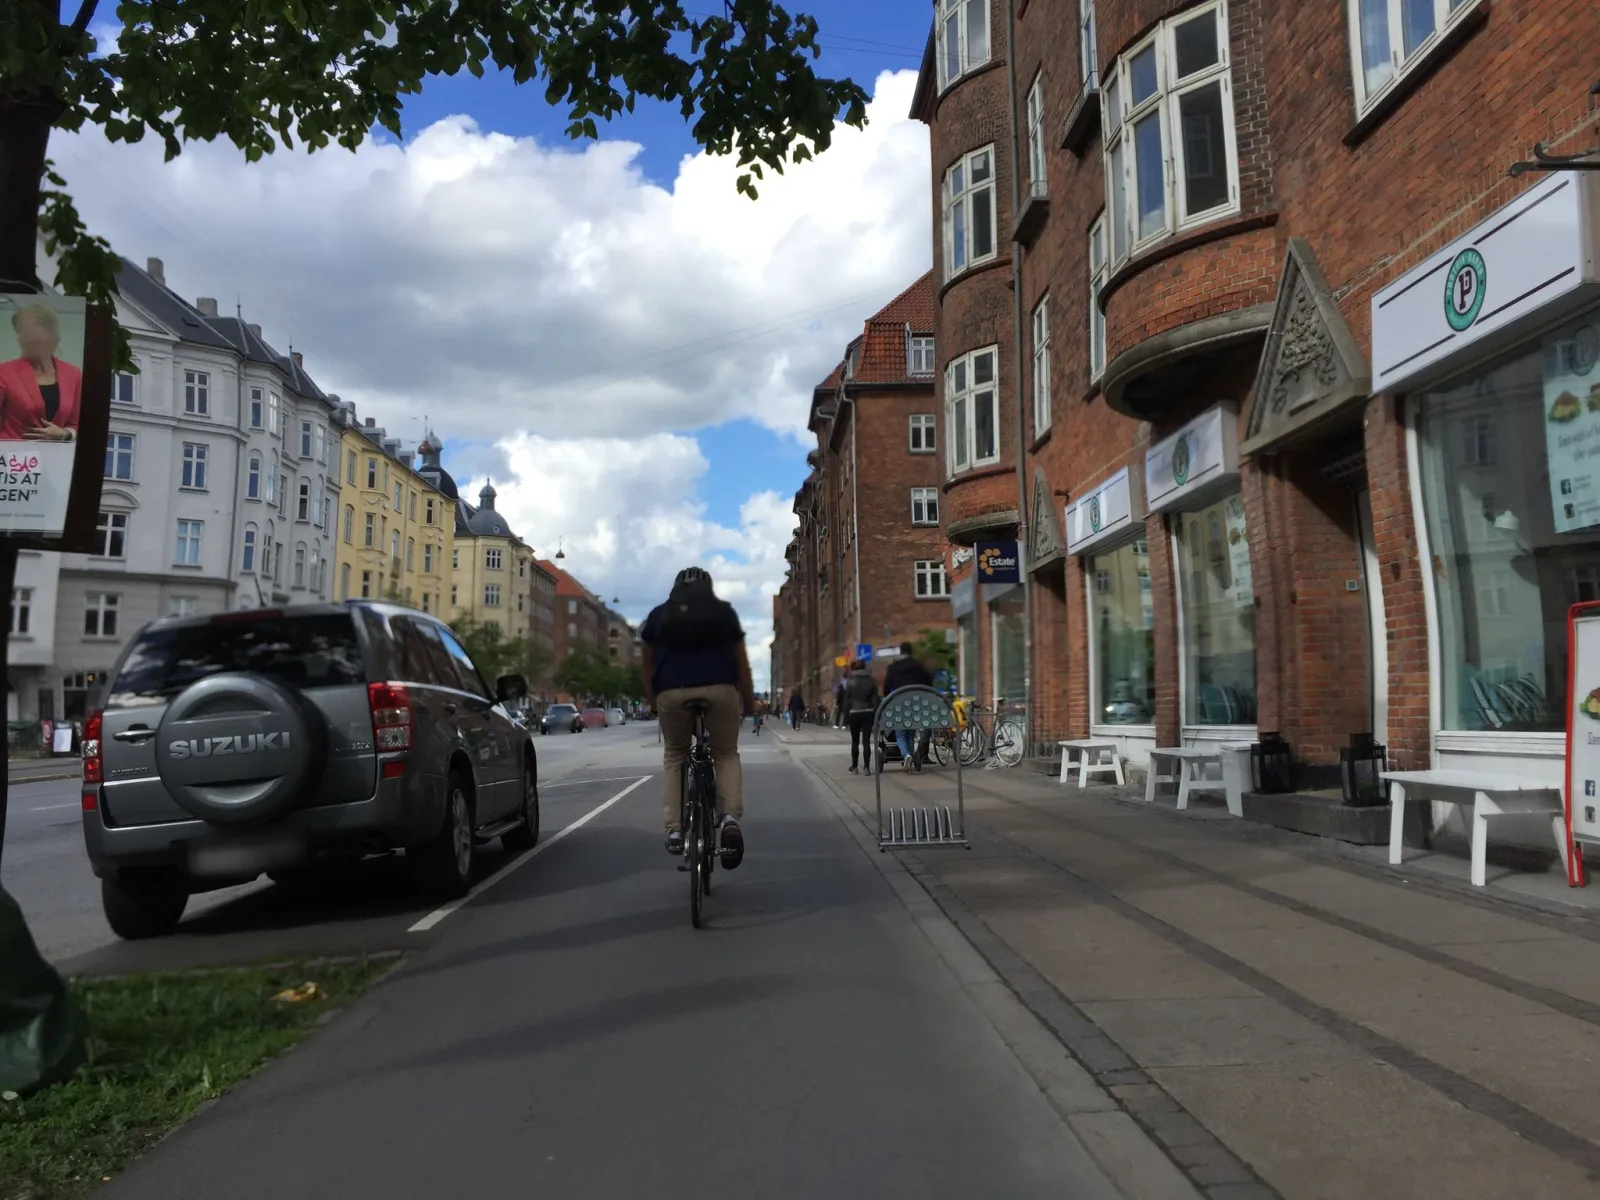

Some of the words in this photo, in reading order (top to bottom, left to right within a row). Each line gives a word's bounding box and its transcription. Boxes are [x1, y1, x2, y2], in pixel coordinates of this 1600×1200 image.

[1458, 269, 1472, 311] P
[21, 472, 41, 485] AT
[989, 557, 1015, 566] Estate
[169, 731, 291, 759] SUZUKI
